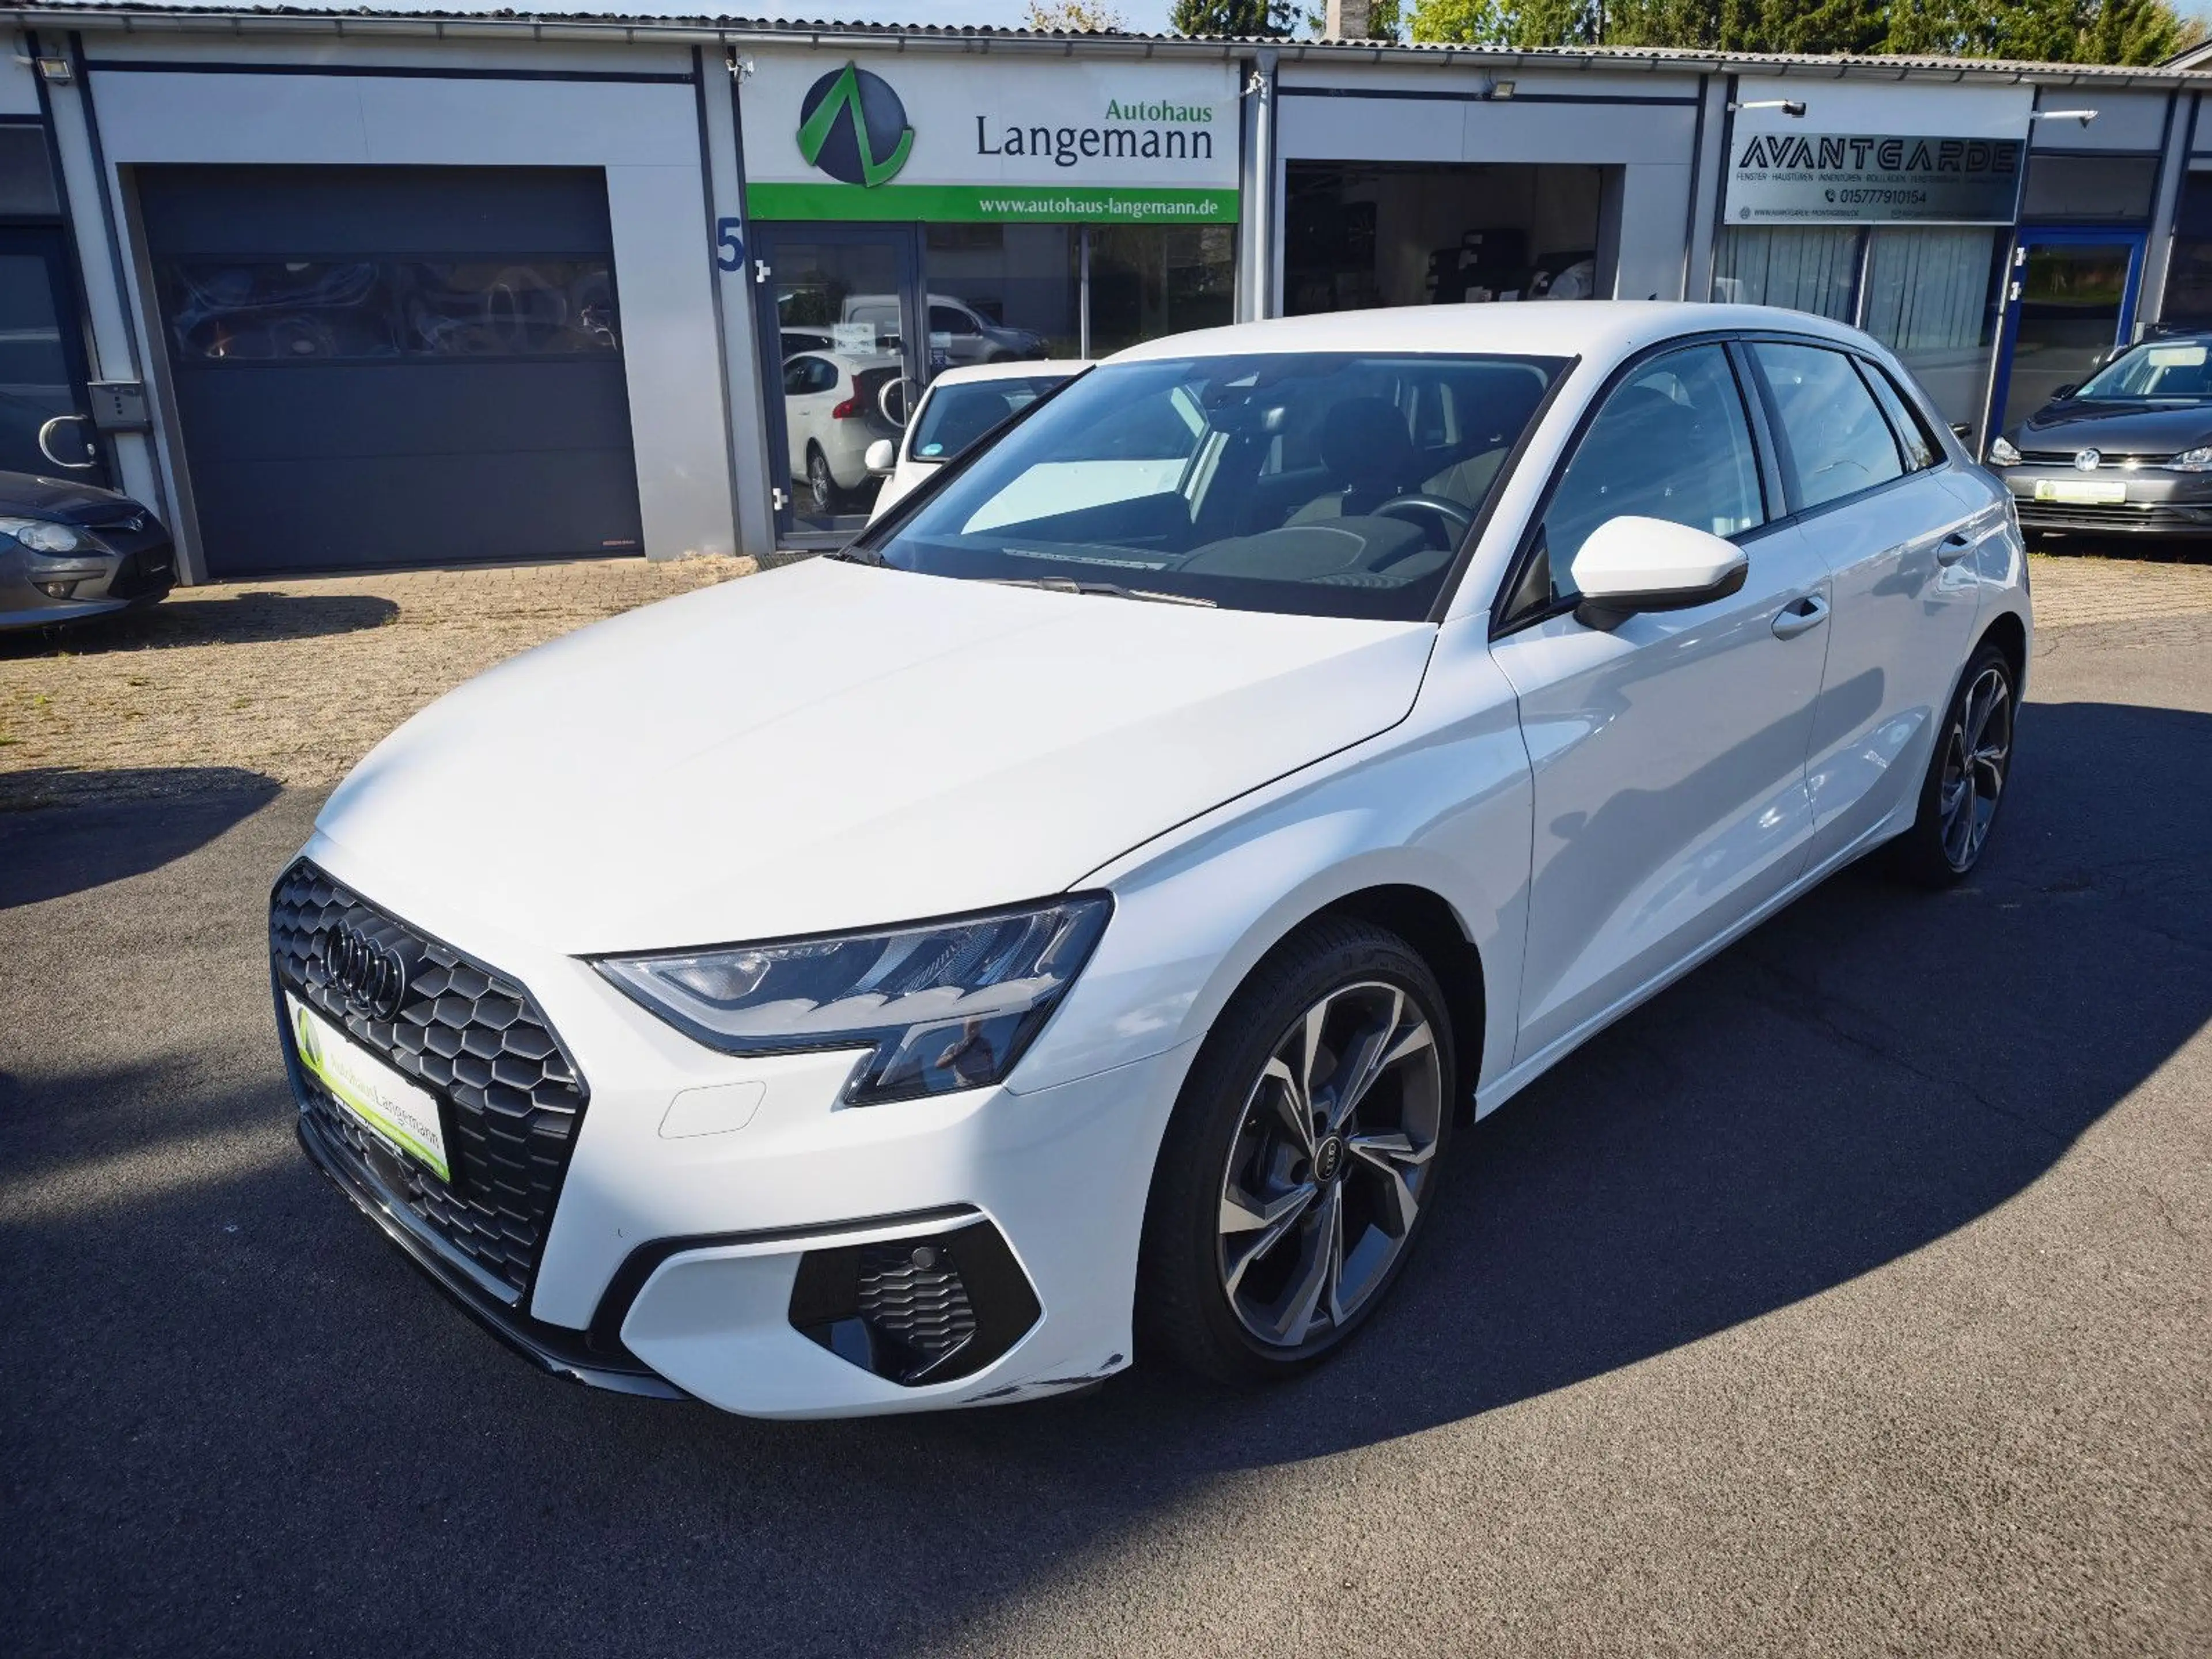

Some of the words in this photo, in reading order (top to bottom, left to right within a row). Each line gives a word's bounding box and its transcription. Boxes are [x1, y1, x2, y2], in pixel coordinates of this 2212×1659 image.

[1105, 99, 1213, 123] Autohaus
[976, 115, 1213, 167] Langemann
[1738, 135, 2016, 173] AVANTGARDE
[979, 198, 1219, 218] www.autohaus-langemann.de
[1840, 189, 1926, 204] 015777910154
[717, 217, 745, 271] 5
